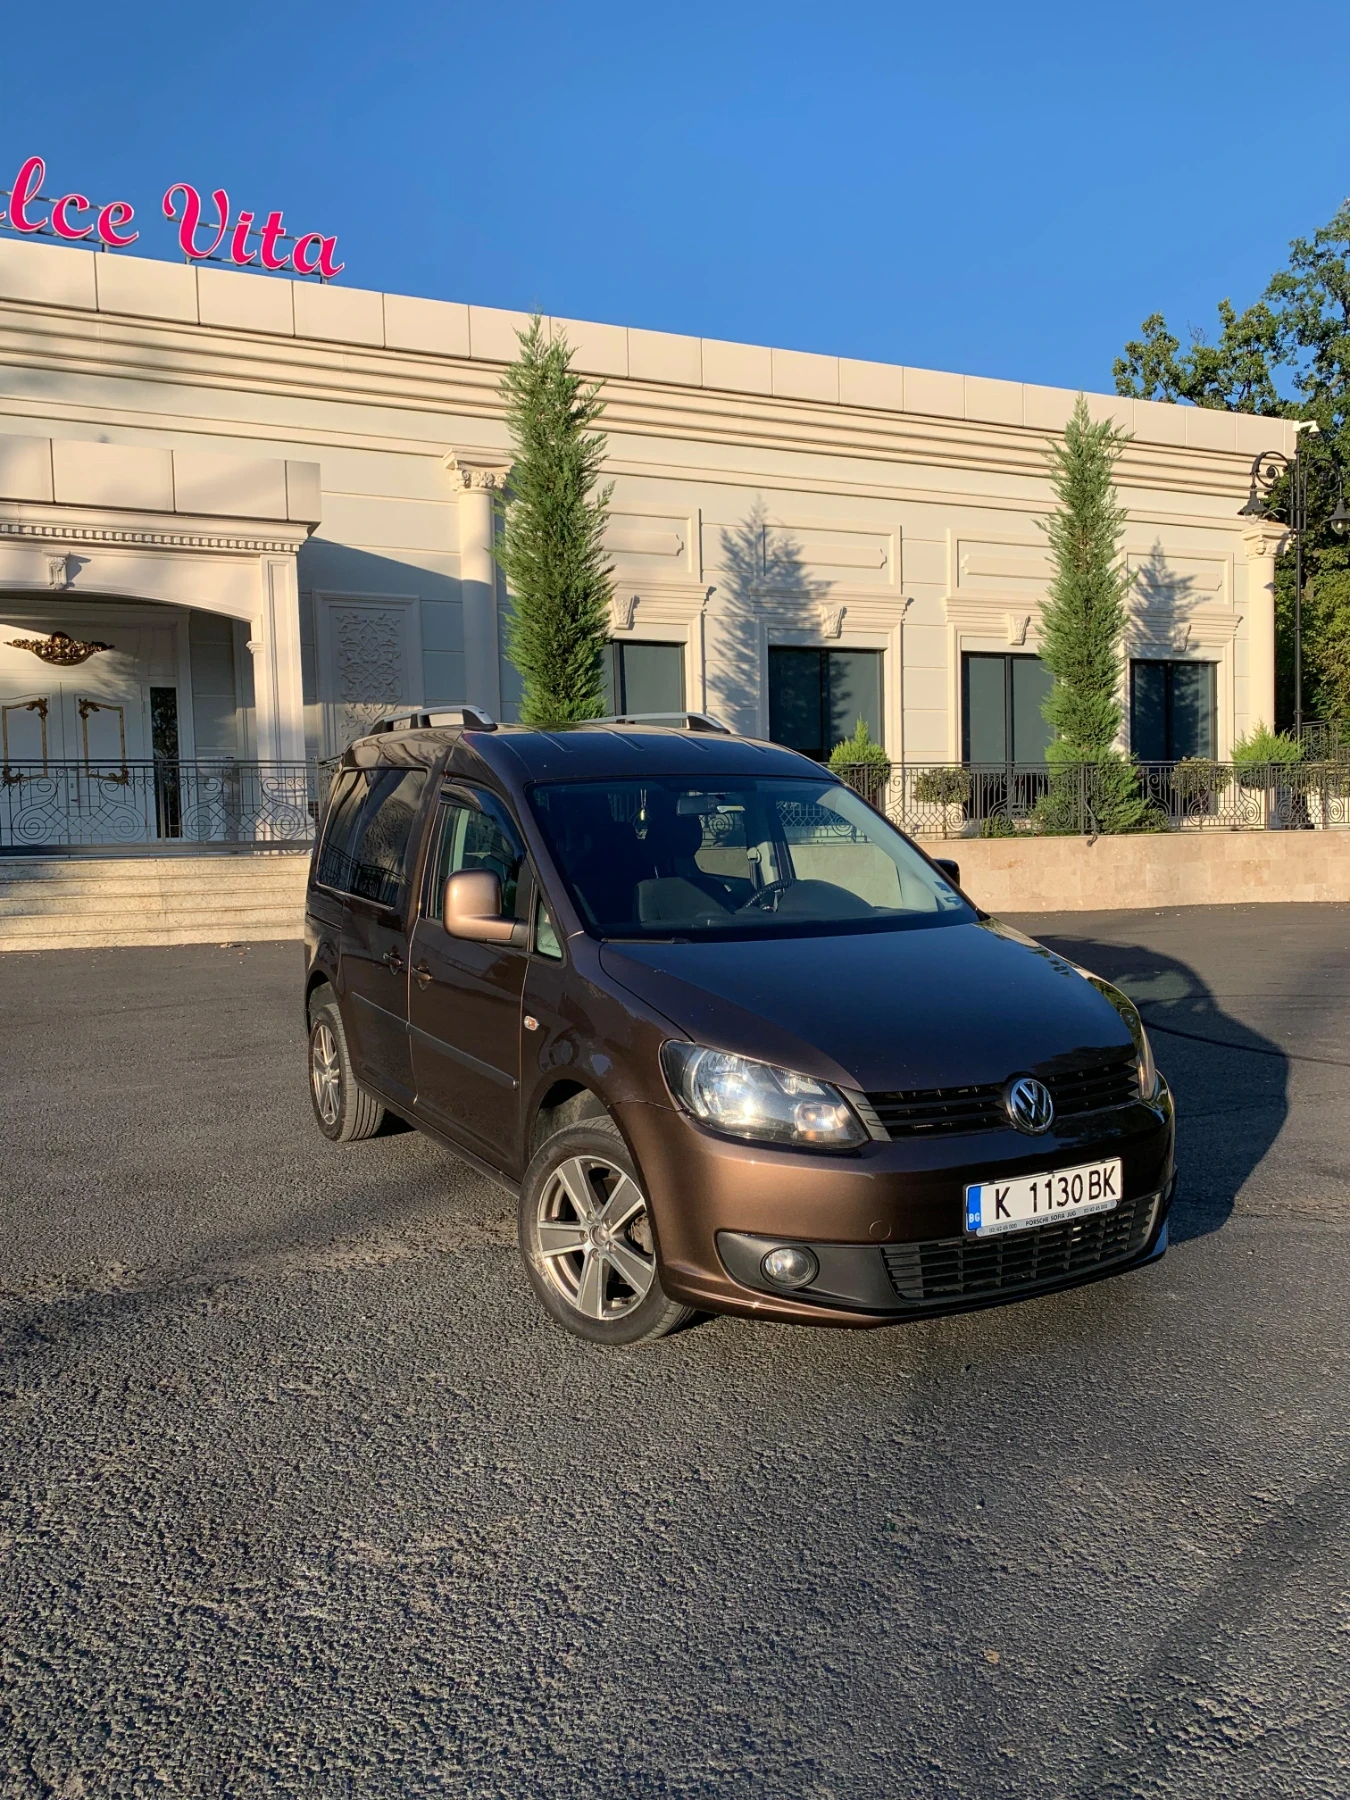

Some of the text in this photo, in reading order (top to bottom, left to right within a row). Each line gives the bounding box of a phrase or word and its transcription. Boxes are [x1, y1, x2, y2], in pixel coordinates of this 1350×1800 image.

[0, 156, 345, 278] lce Vita
[995, 1165, 1116, 1220] K 1130 BK
[969, 1212, 981, 1223] BG
[1025, 1216, 1049, 1226] PORSCHE
[1051, 1212, 1065, 1221] SOFIA
[1067, 1210, 1077, 1218] JUG
